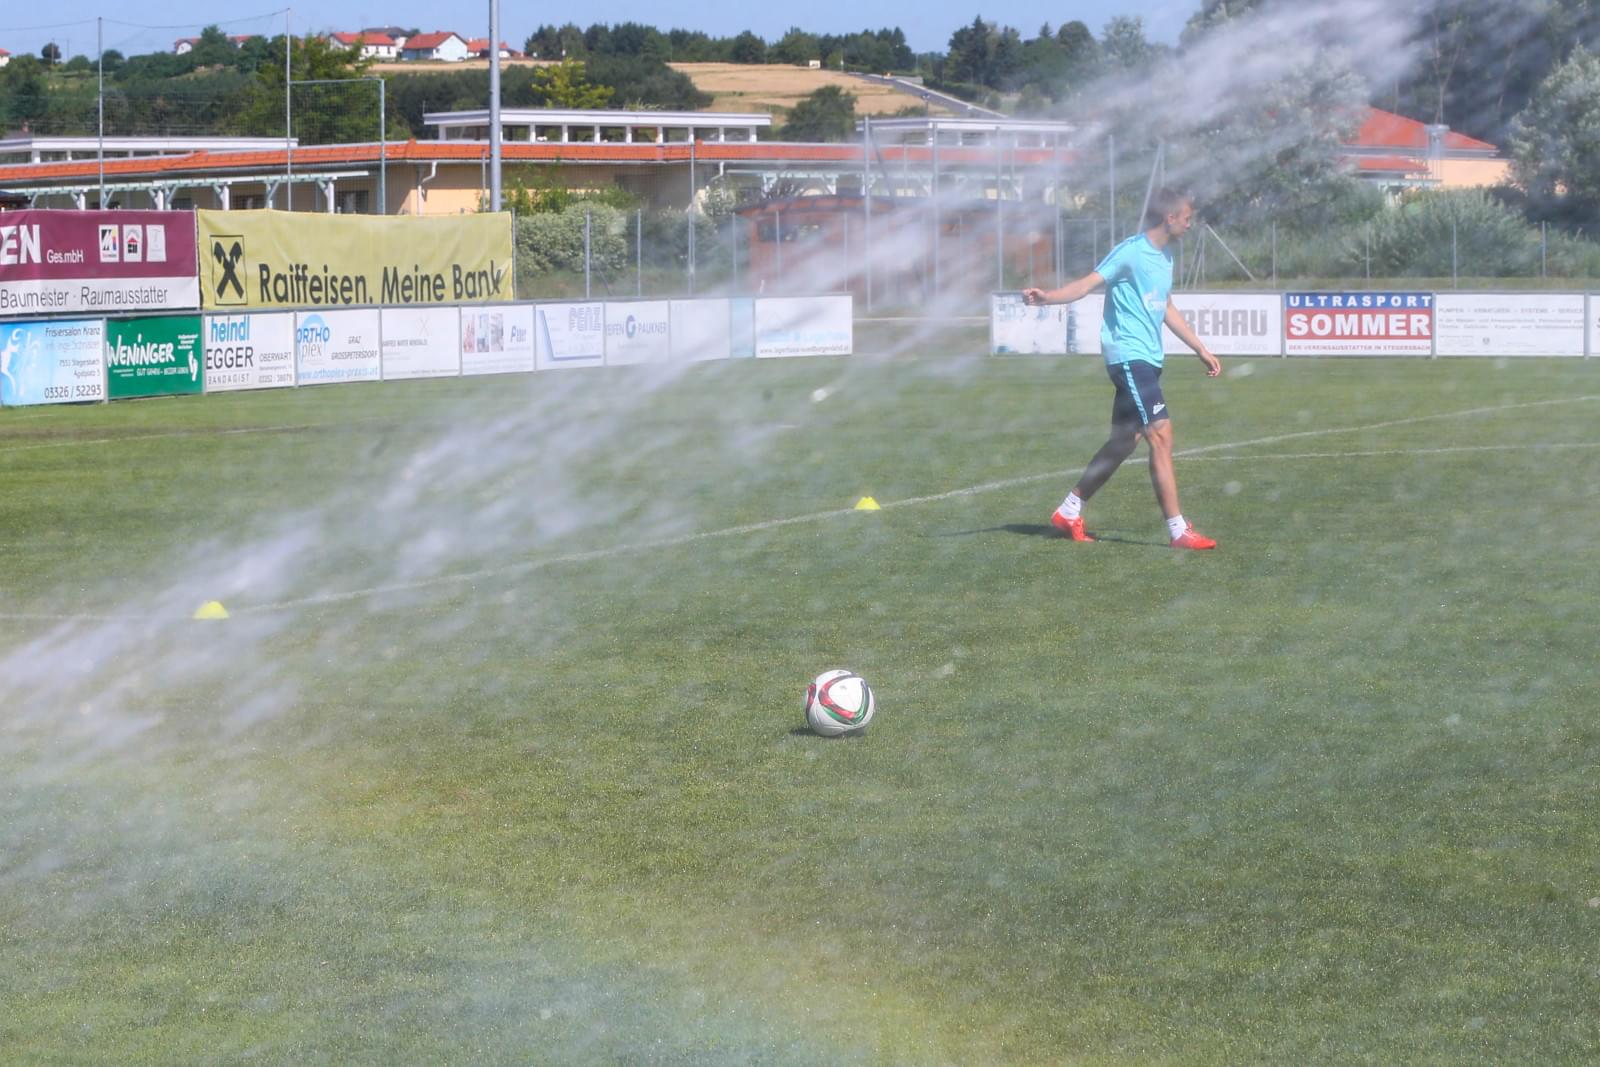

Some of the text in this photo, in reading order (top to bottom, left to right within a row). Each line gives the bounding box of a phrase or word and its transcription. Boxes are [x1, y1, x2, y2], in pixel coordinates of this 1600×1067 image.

[259, 260, 503, 304] Raiffeisen. Meine Bank
[0, 286, 168, 309] Baumeister Raumausstatter
[1289, 295, 1432, 307] ULTRASPORT
[211, 315, 250, 342] heindl
[296, 327, 330, 343] ORTHO
[1289, 313, 1431, 337] SOMMER
[206, 346, 254, 370] EGGER
[44, 386, 69, 398] 03326
[76, 384, 101, 397] 52293
